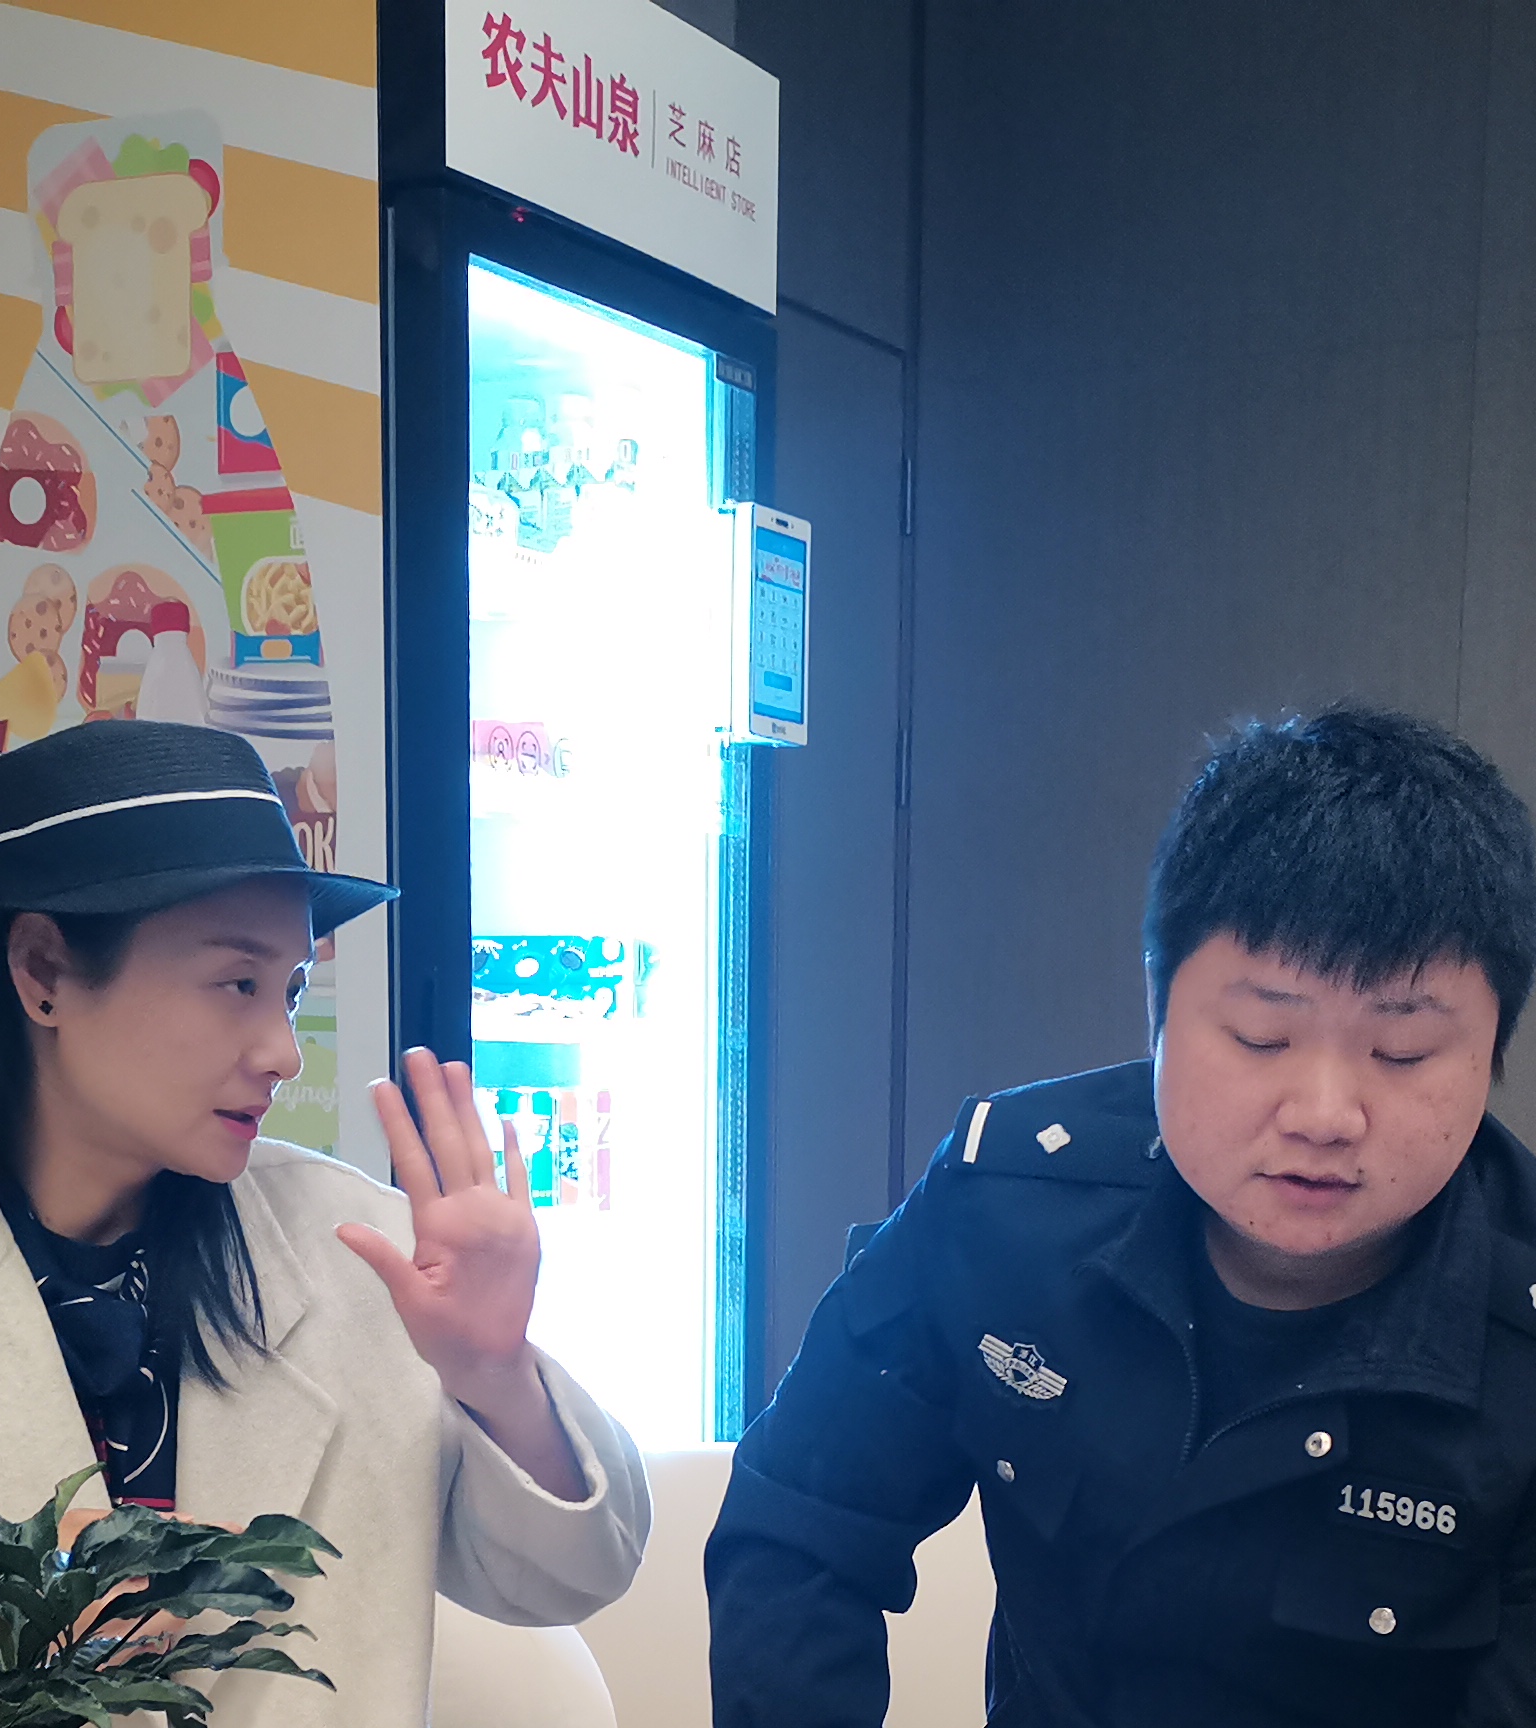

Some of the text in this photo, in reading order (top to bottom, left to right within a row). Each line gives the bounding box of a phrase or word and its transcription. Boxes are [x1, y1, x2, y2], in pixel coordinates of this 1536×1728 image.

[481, 10, 640, 158] 农夫山泉
[668, 102, 741, 178] 芝麻店
[666, 157, 756, 222] INTELLIGENT STORE
[1338, 1484, 1456, 1534] 115966
